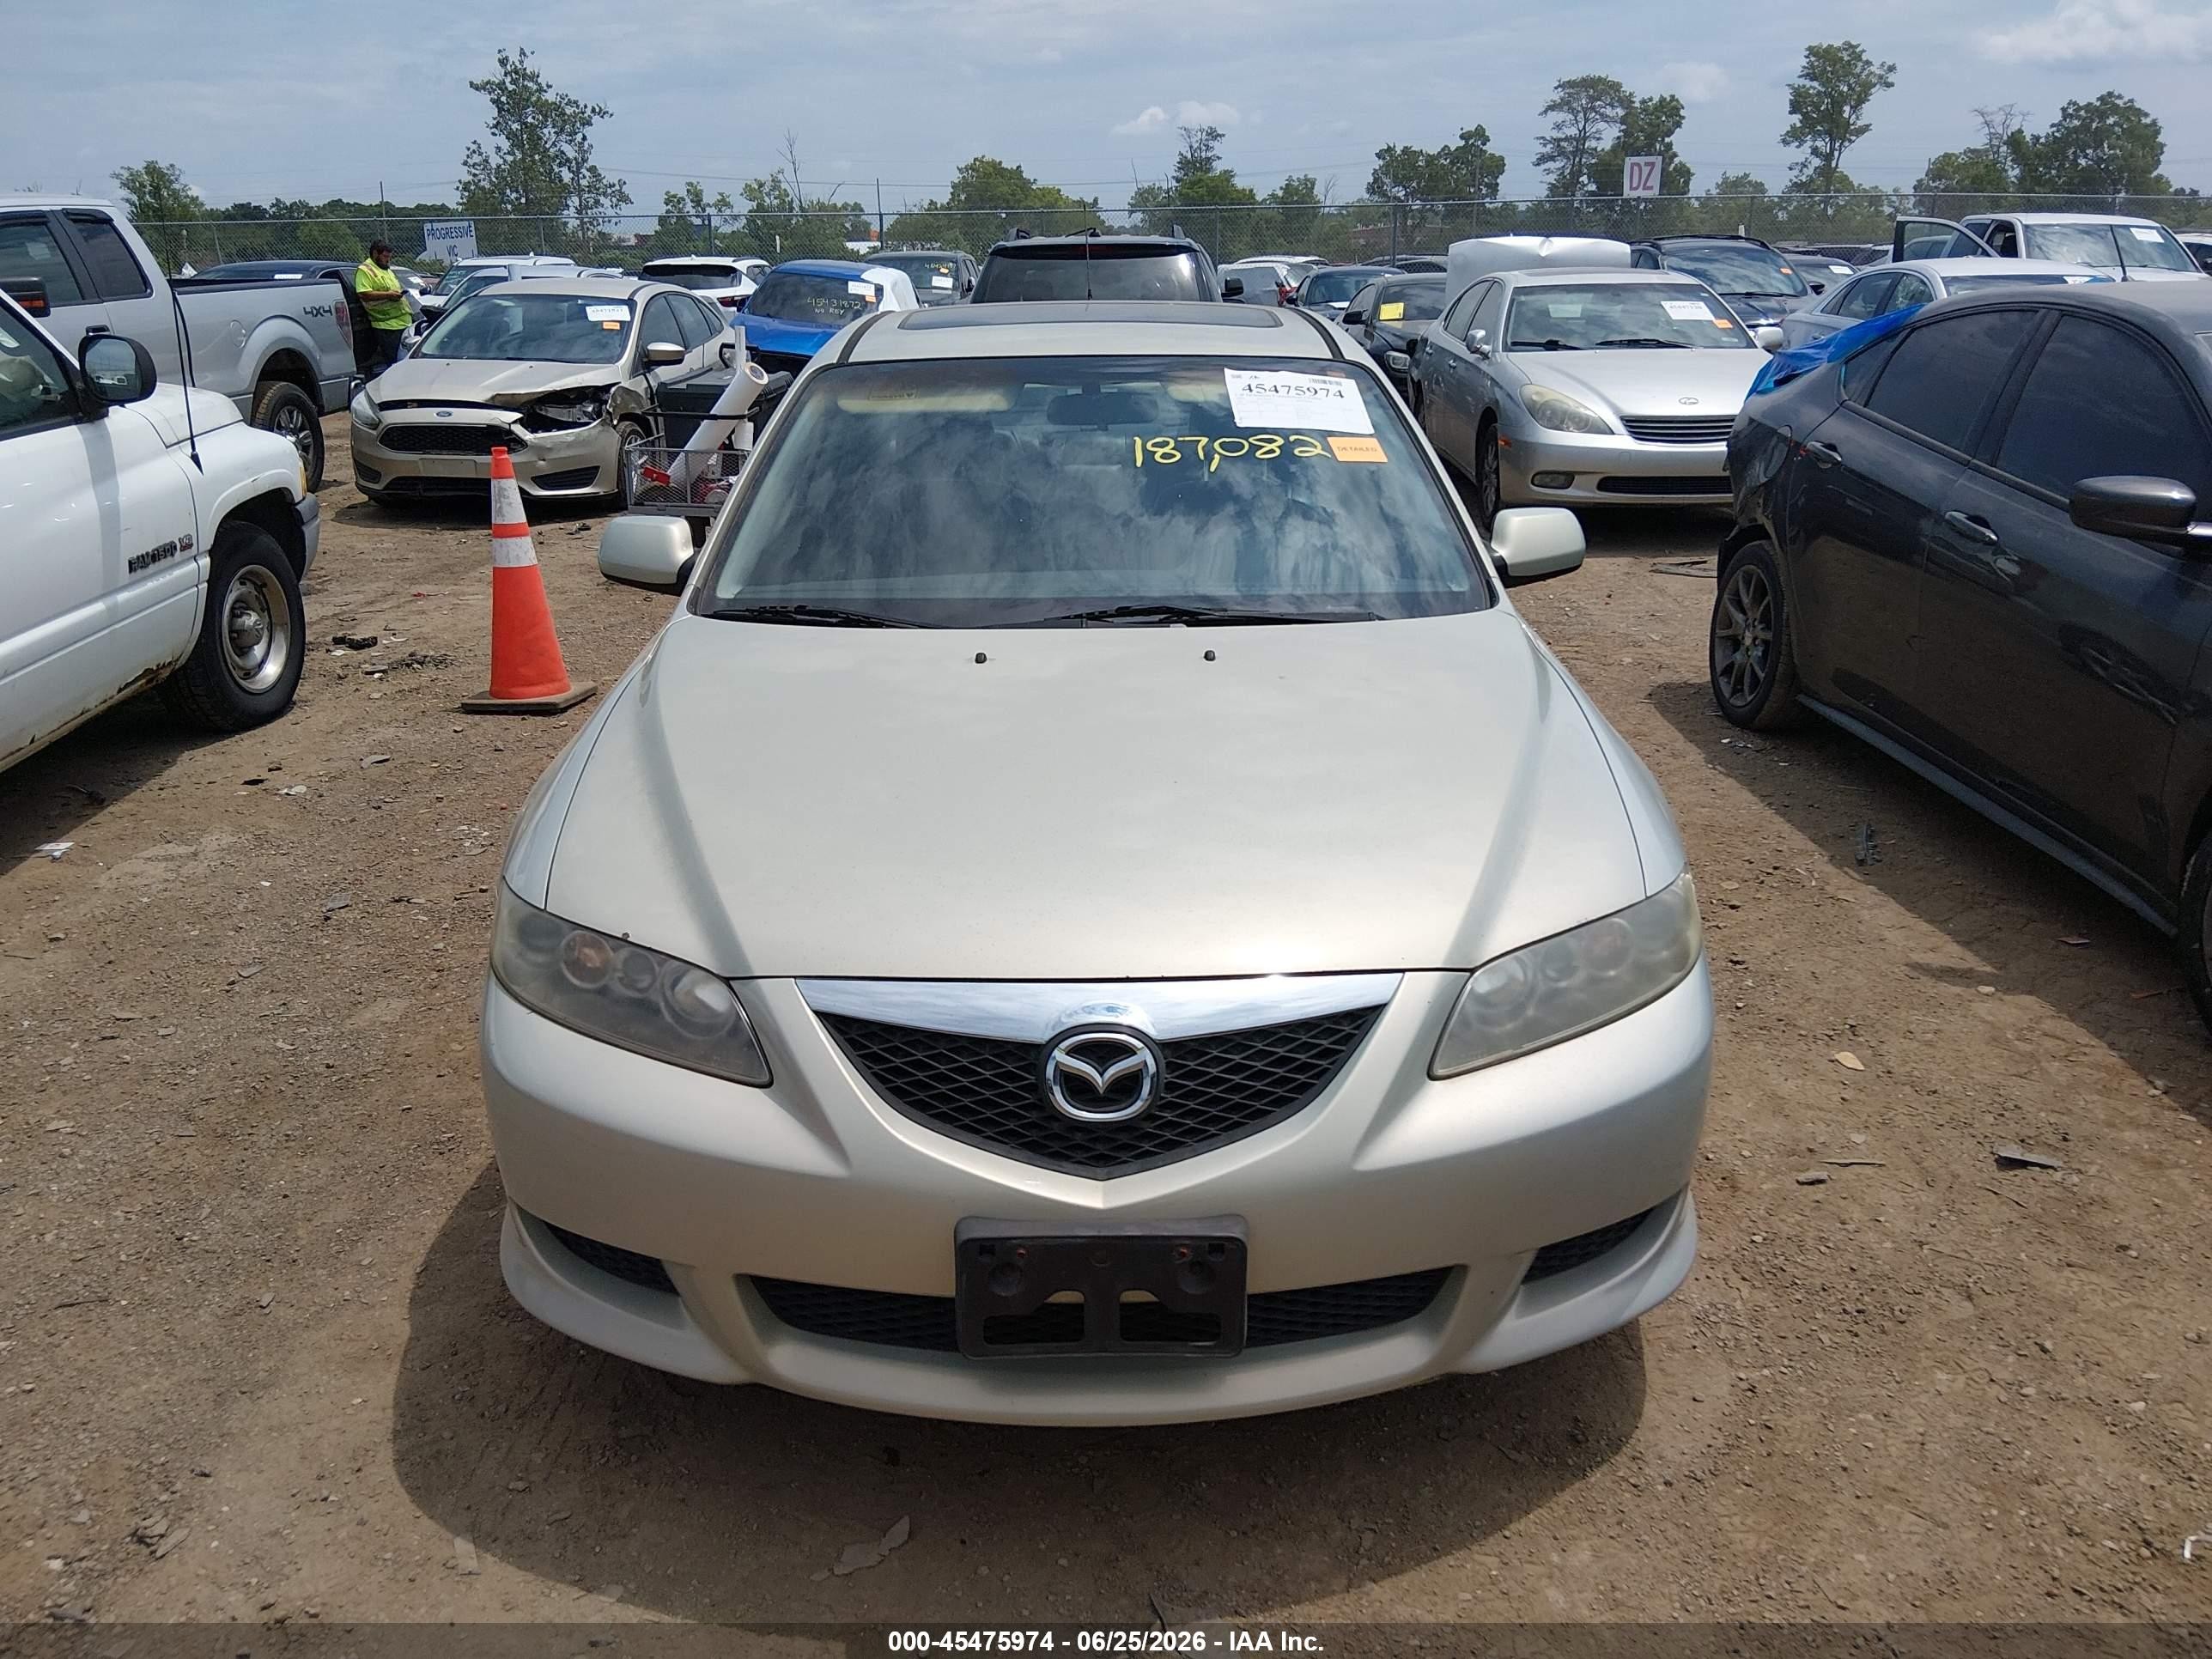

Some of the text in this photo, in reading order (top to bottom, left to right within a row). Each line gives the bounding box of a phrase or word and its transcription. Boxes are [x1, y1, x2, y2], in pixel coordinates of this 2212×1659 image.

[1630, 161, 1656, 191] DZ
[427, 224, 474, 240] PROGRESSIVE
[447, 245, 459, 257] VIC
[1242, 383, 1345, 399] 45475974
[1133, 434, 1332, 472] 187,082
